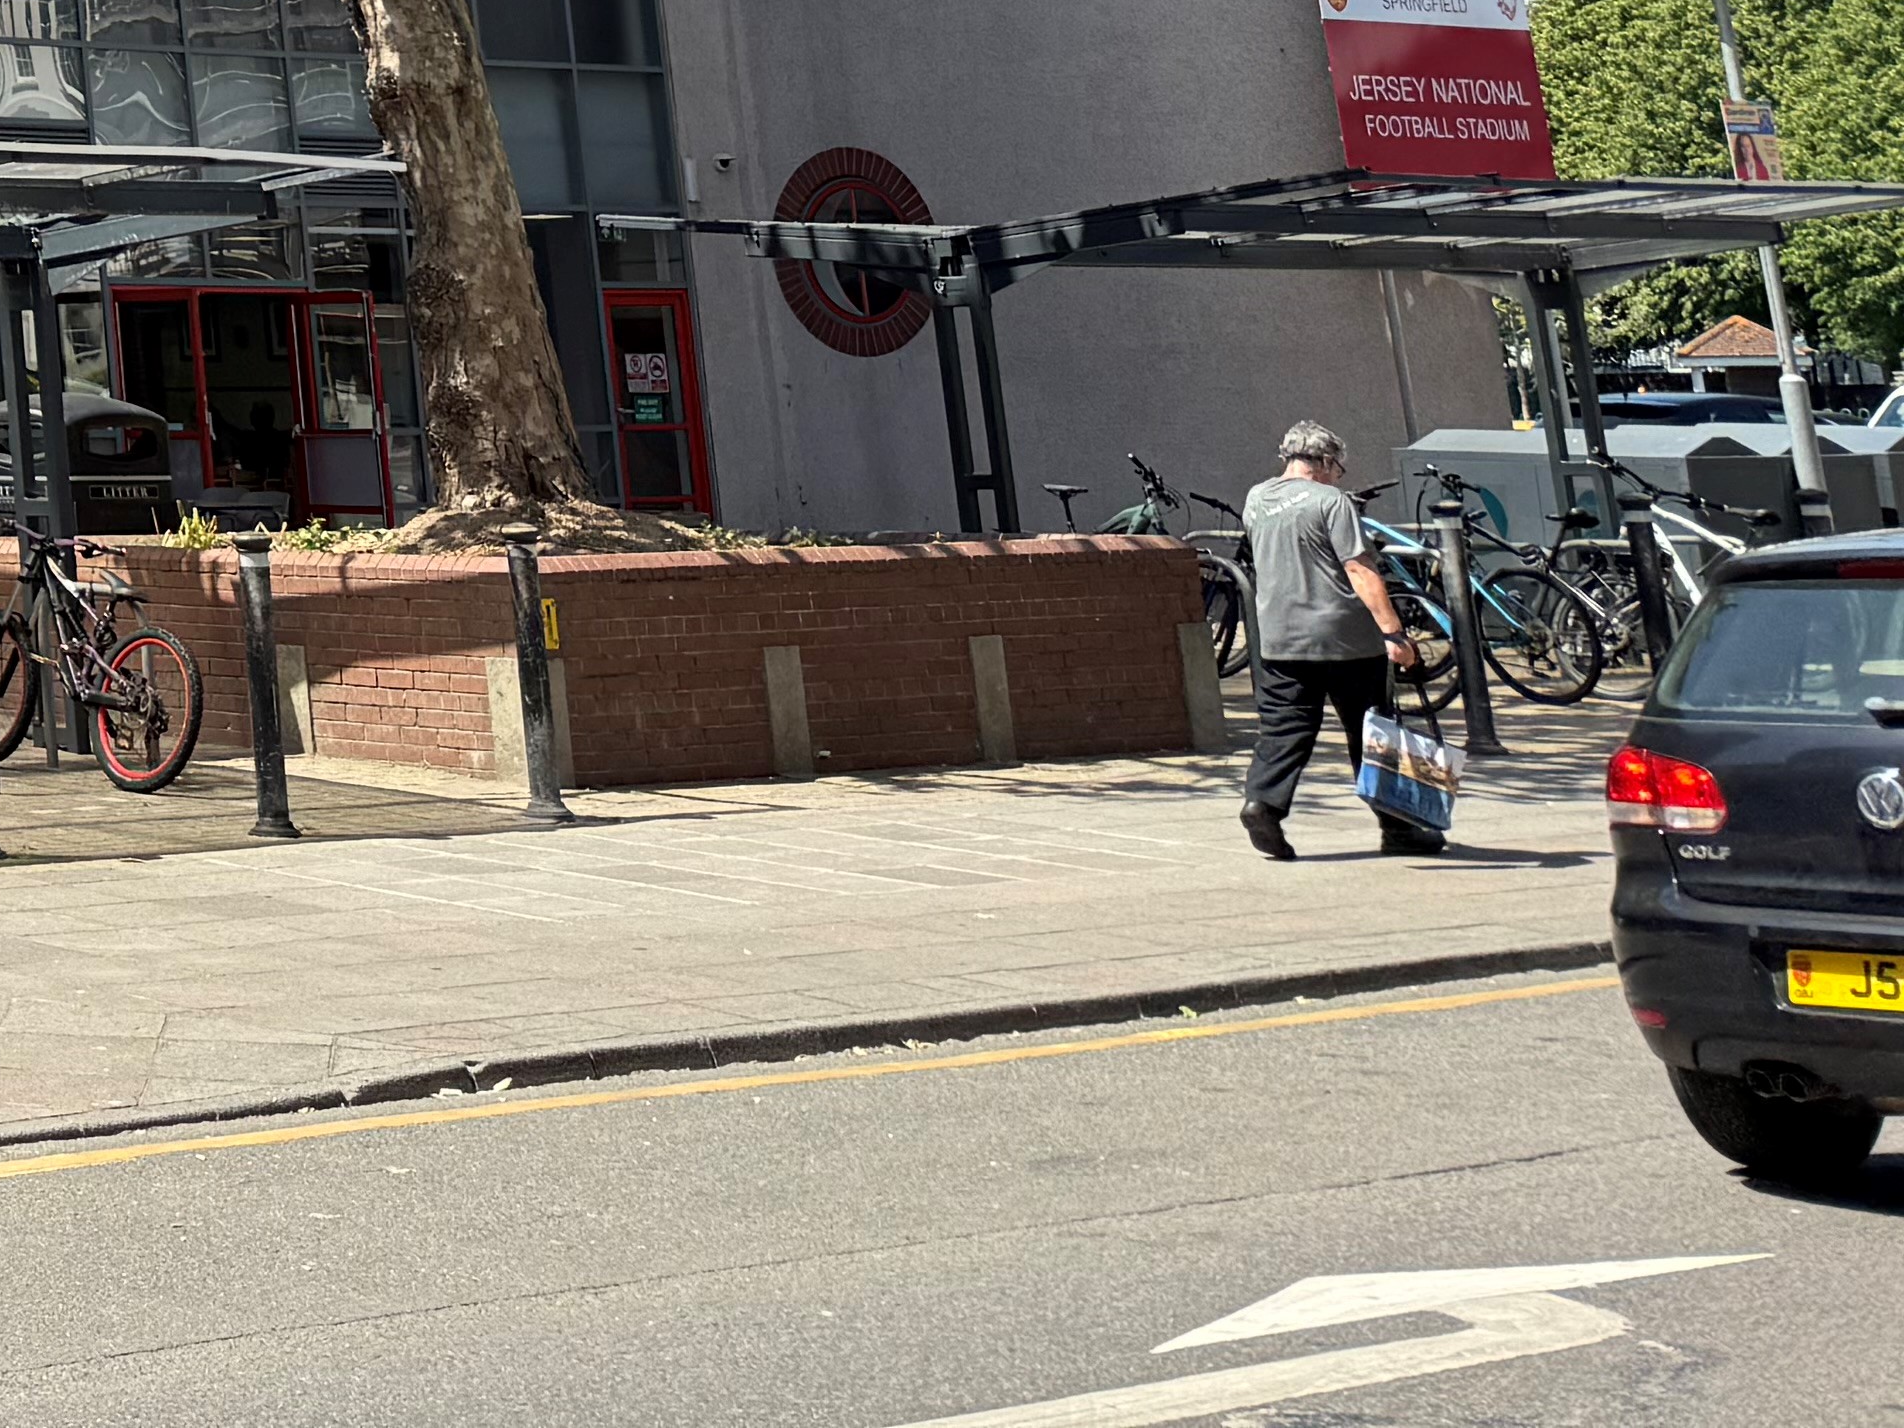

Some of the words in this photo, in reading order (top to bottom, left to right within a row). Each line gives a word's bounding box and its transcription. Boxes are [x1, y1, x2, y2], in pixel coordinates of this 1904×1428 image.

[1349, 75, 1426, 102] JERSEY
[1431, 77, 1531, 106] NATIONAL
[1365, 114, 1454, 139] FOOTBALL
[1456, 117, 1530, 141] STADIUM
[103, 485, 149, 497] LITTER
